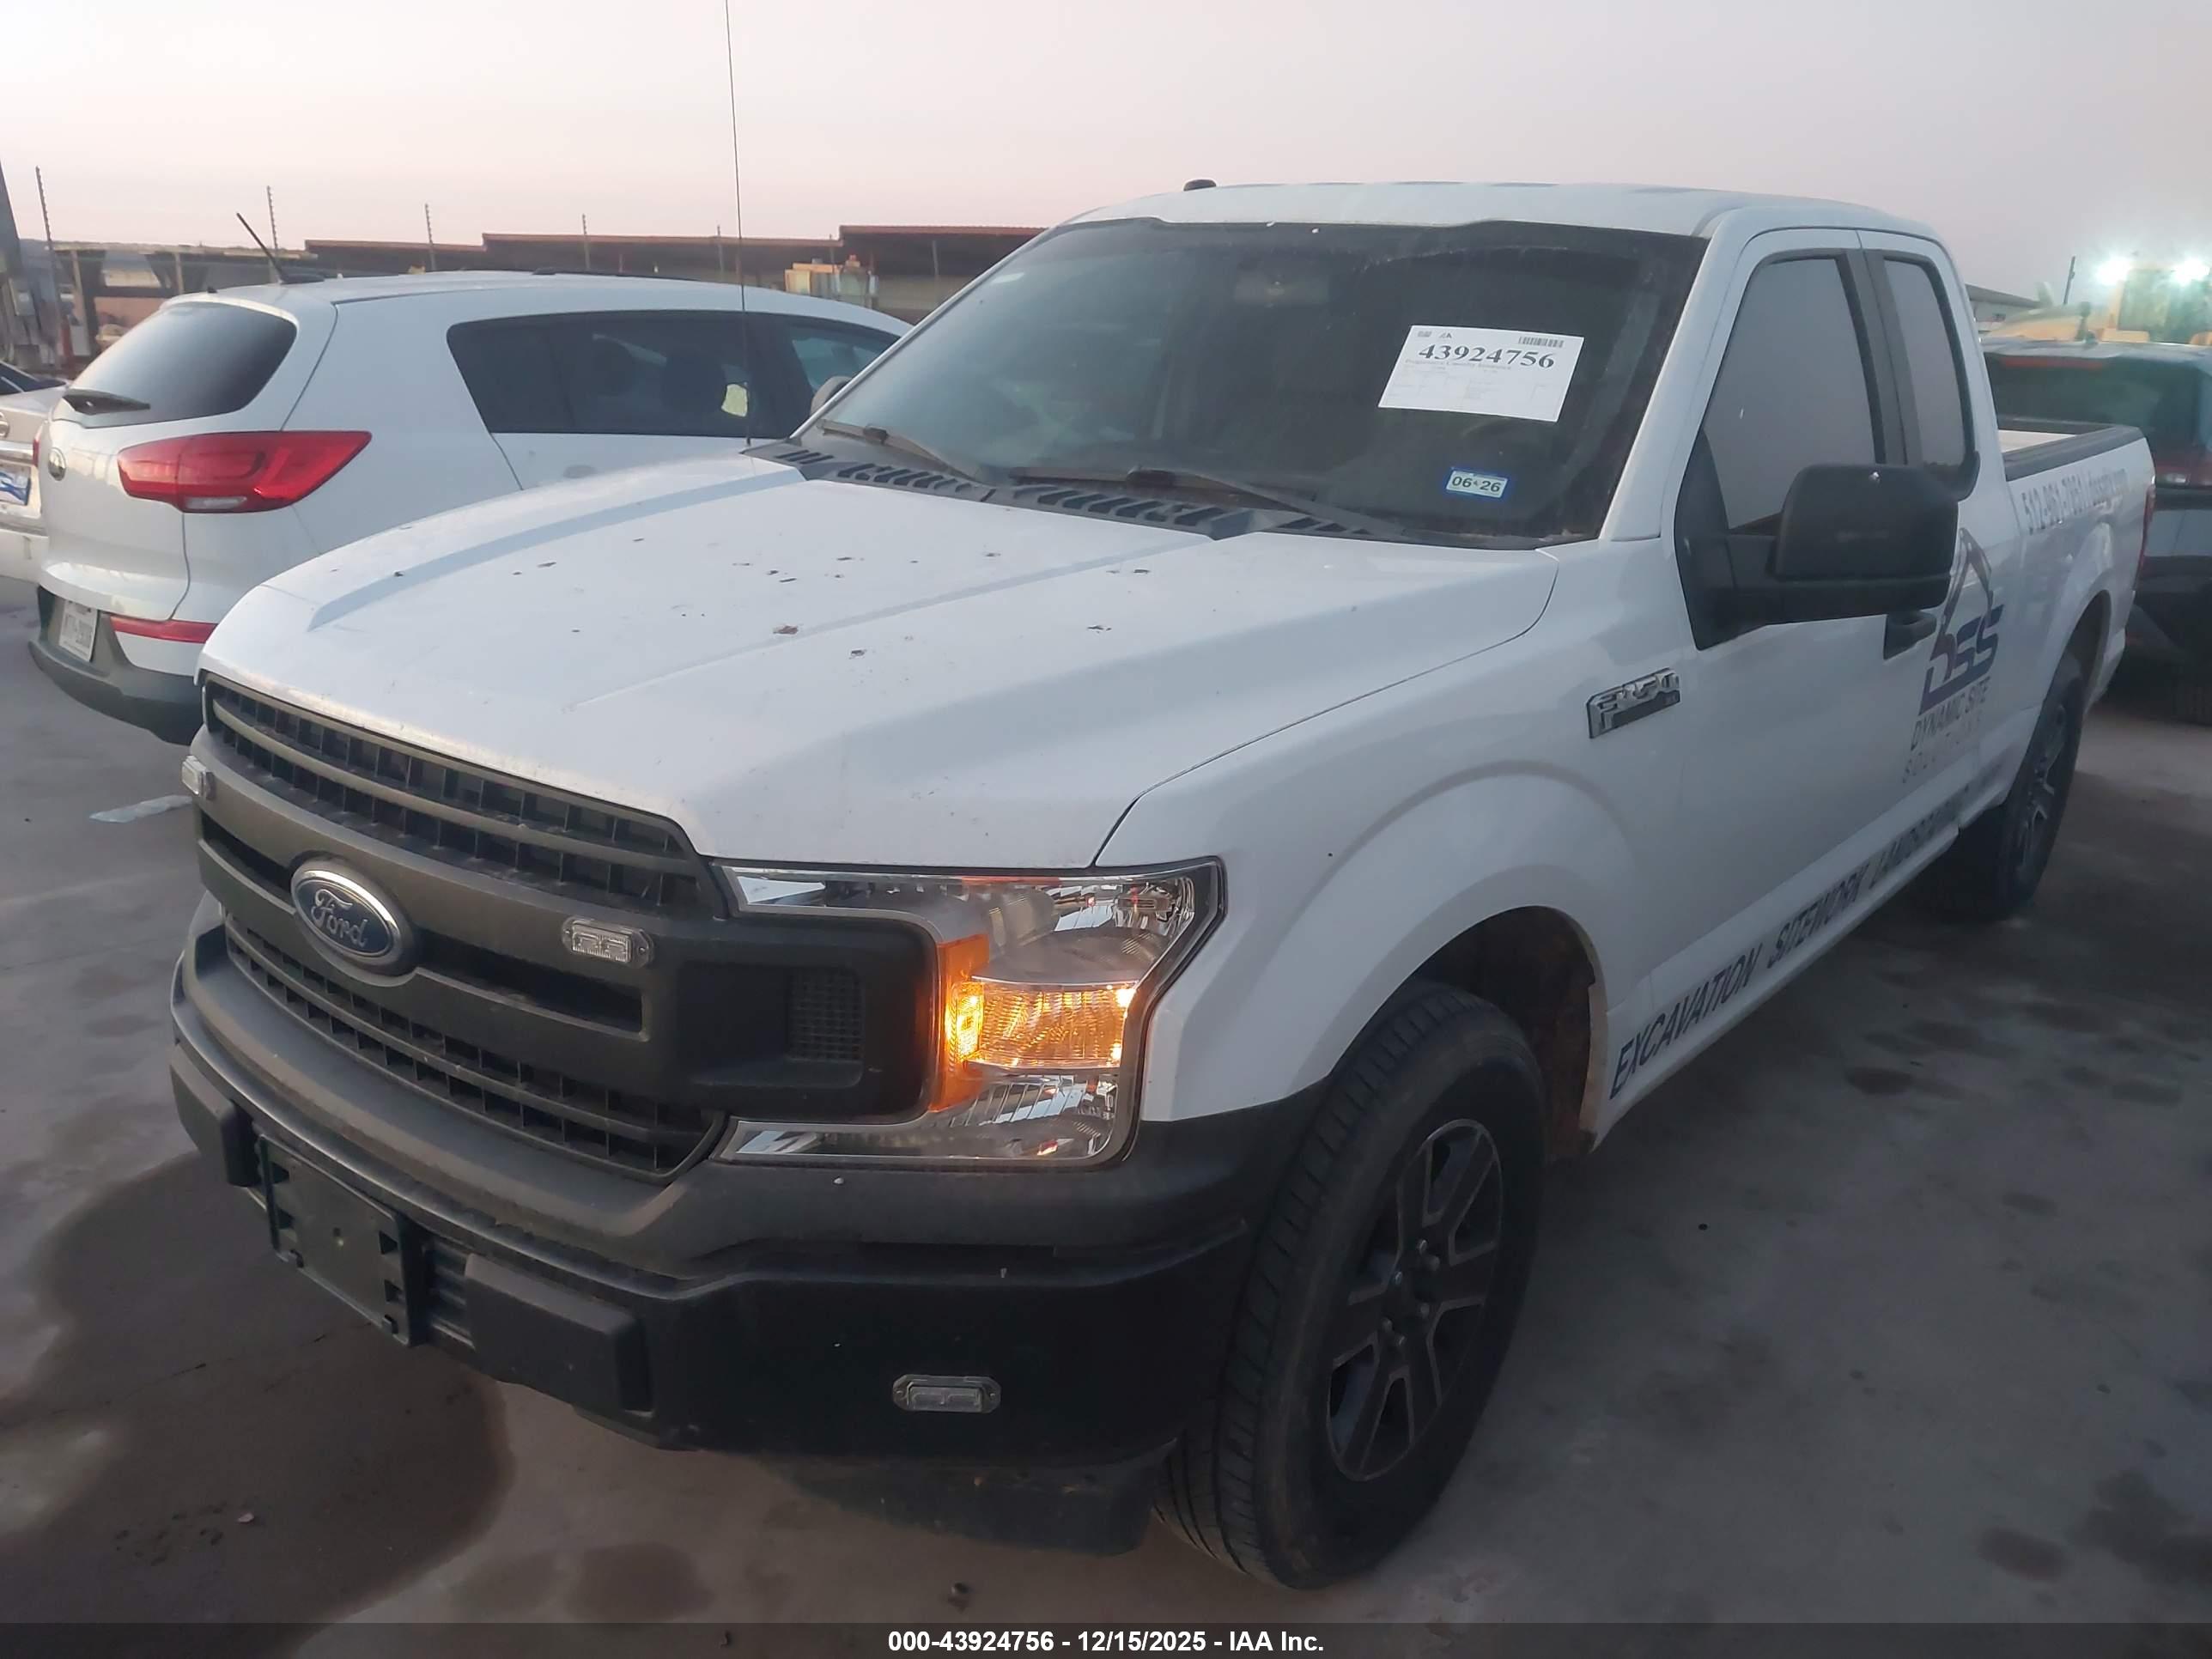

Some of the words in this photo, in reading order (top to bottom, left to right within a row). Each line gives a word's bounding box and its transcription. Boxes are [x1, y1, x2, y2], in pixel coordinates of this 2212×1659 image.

[1419, 343, 1555, 369] 43924756
[1451, 476, 1473, 489] 06
[1480, 479, 1501, 493] 26
[310, 888, 369, 948] Ford
[1609, 944, 1763, 1100] EXCAVATION
